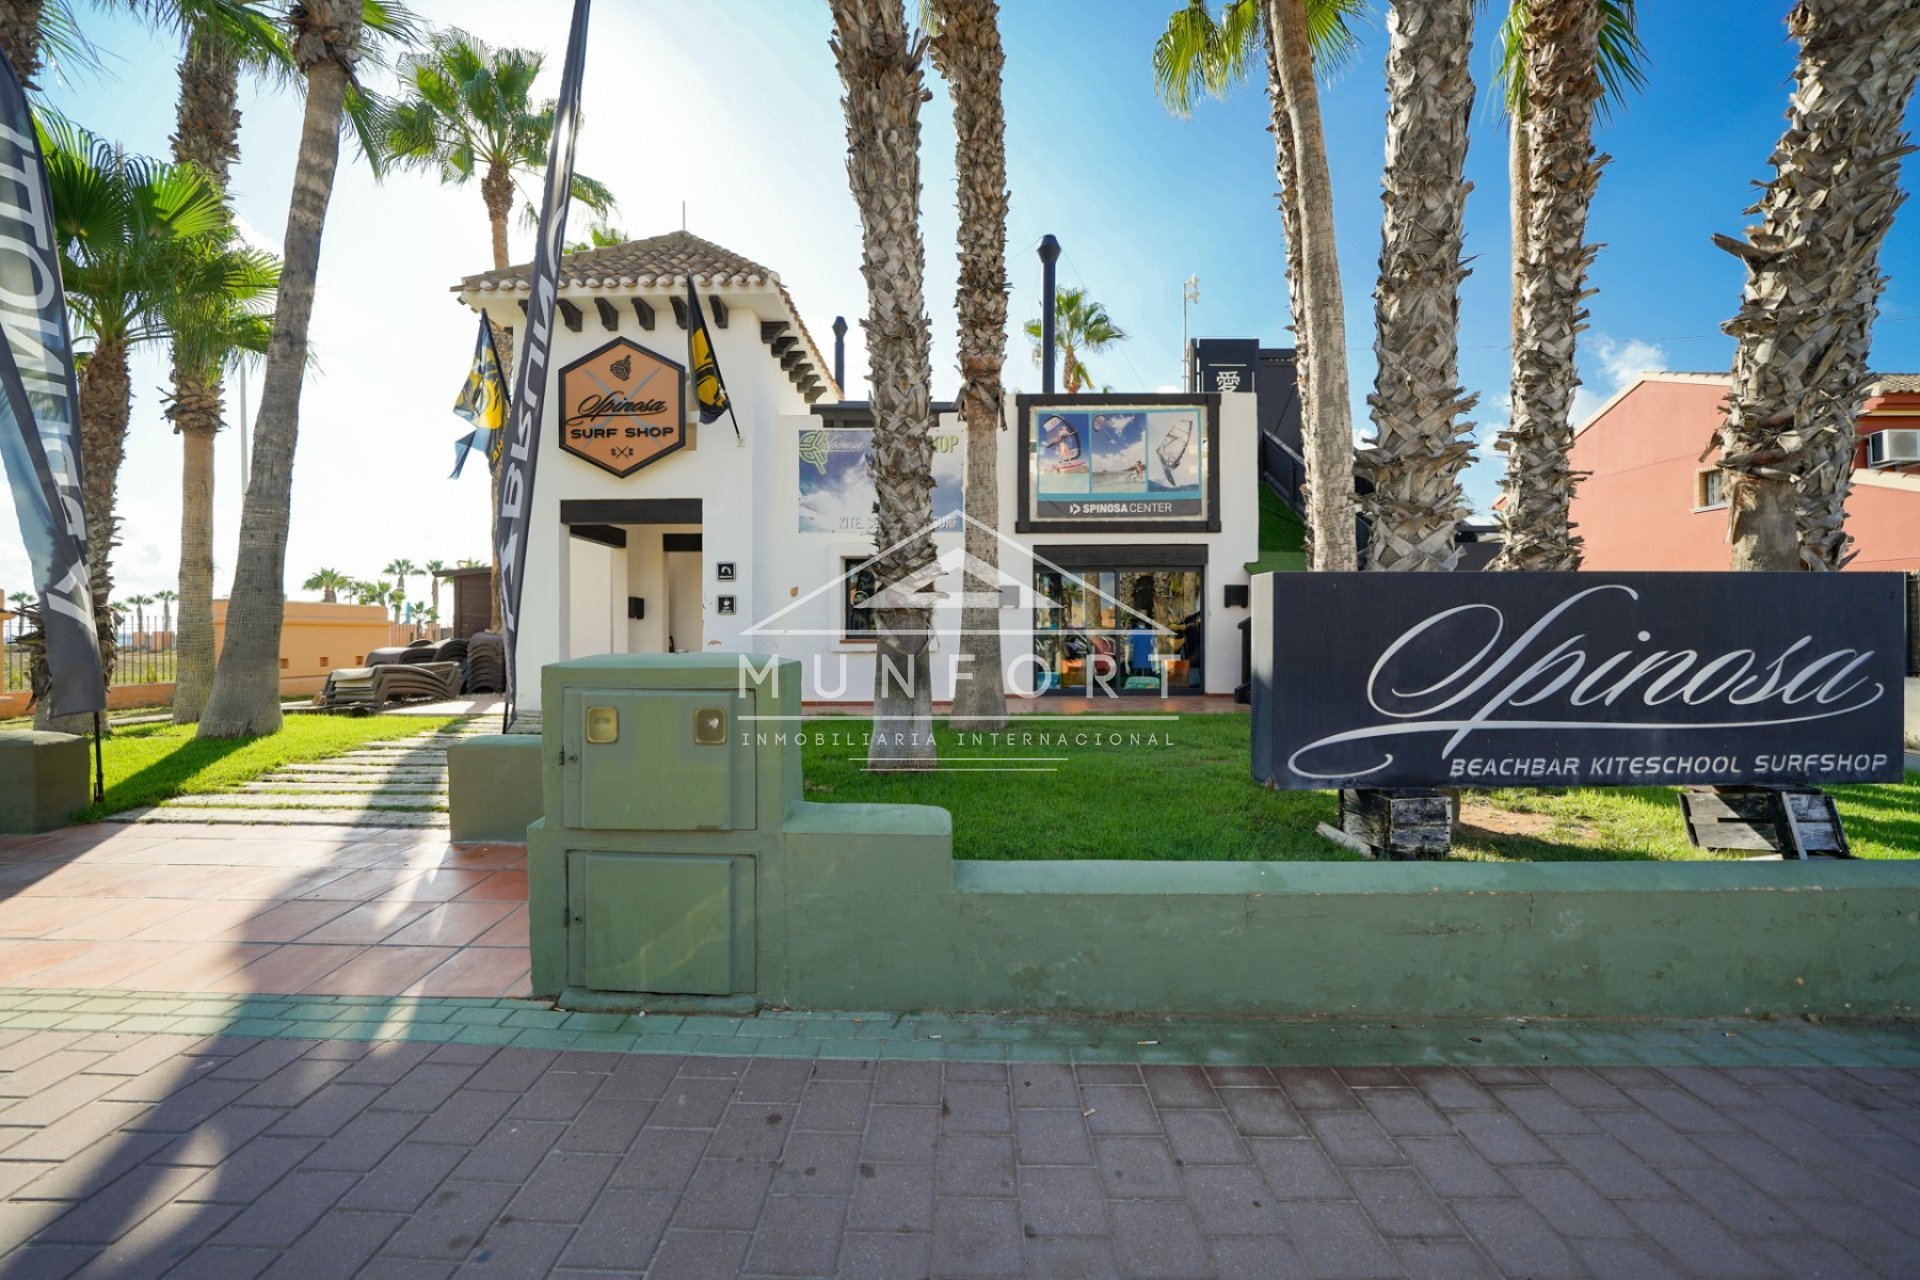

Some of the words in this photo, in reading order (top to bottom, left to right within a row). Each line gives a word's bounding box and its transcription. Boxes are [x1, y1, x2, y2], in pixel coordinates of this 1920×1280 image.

[565, 391, 668, 426] Spinosa
[570, 428, 618, 439] SURF
[625, 427, 674, 438] SHOP
[1083, 503, 1128, 513] SPINOSA
[1129, 502, 1172, 513] CENTER
[1288, 585, 1886, 779] Spinosa
[1450, 757, 1580, 777] BEACHBAR
[1590, 755, 1742, 776] KITESCHOOL
[1754, 753, 1888, 773] SURFSHOP
